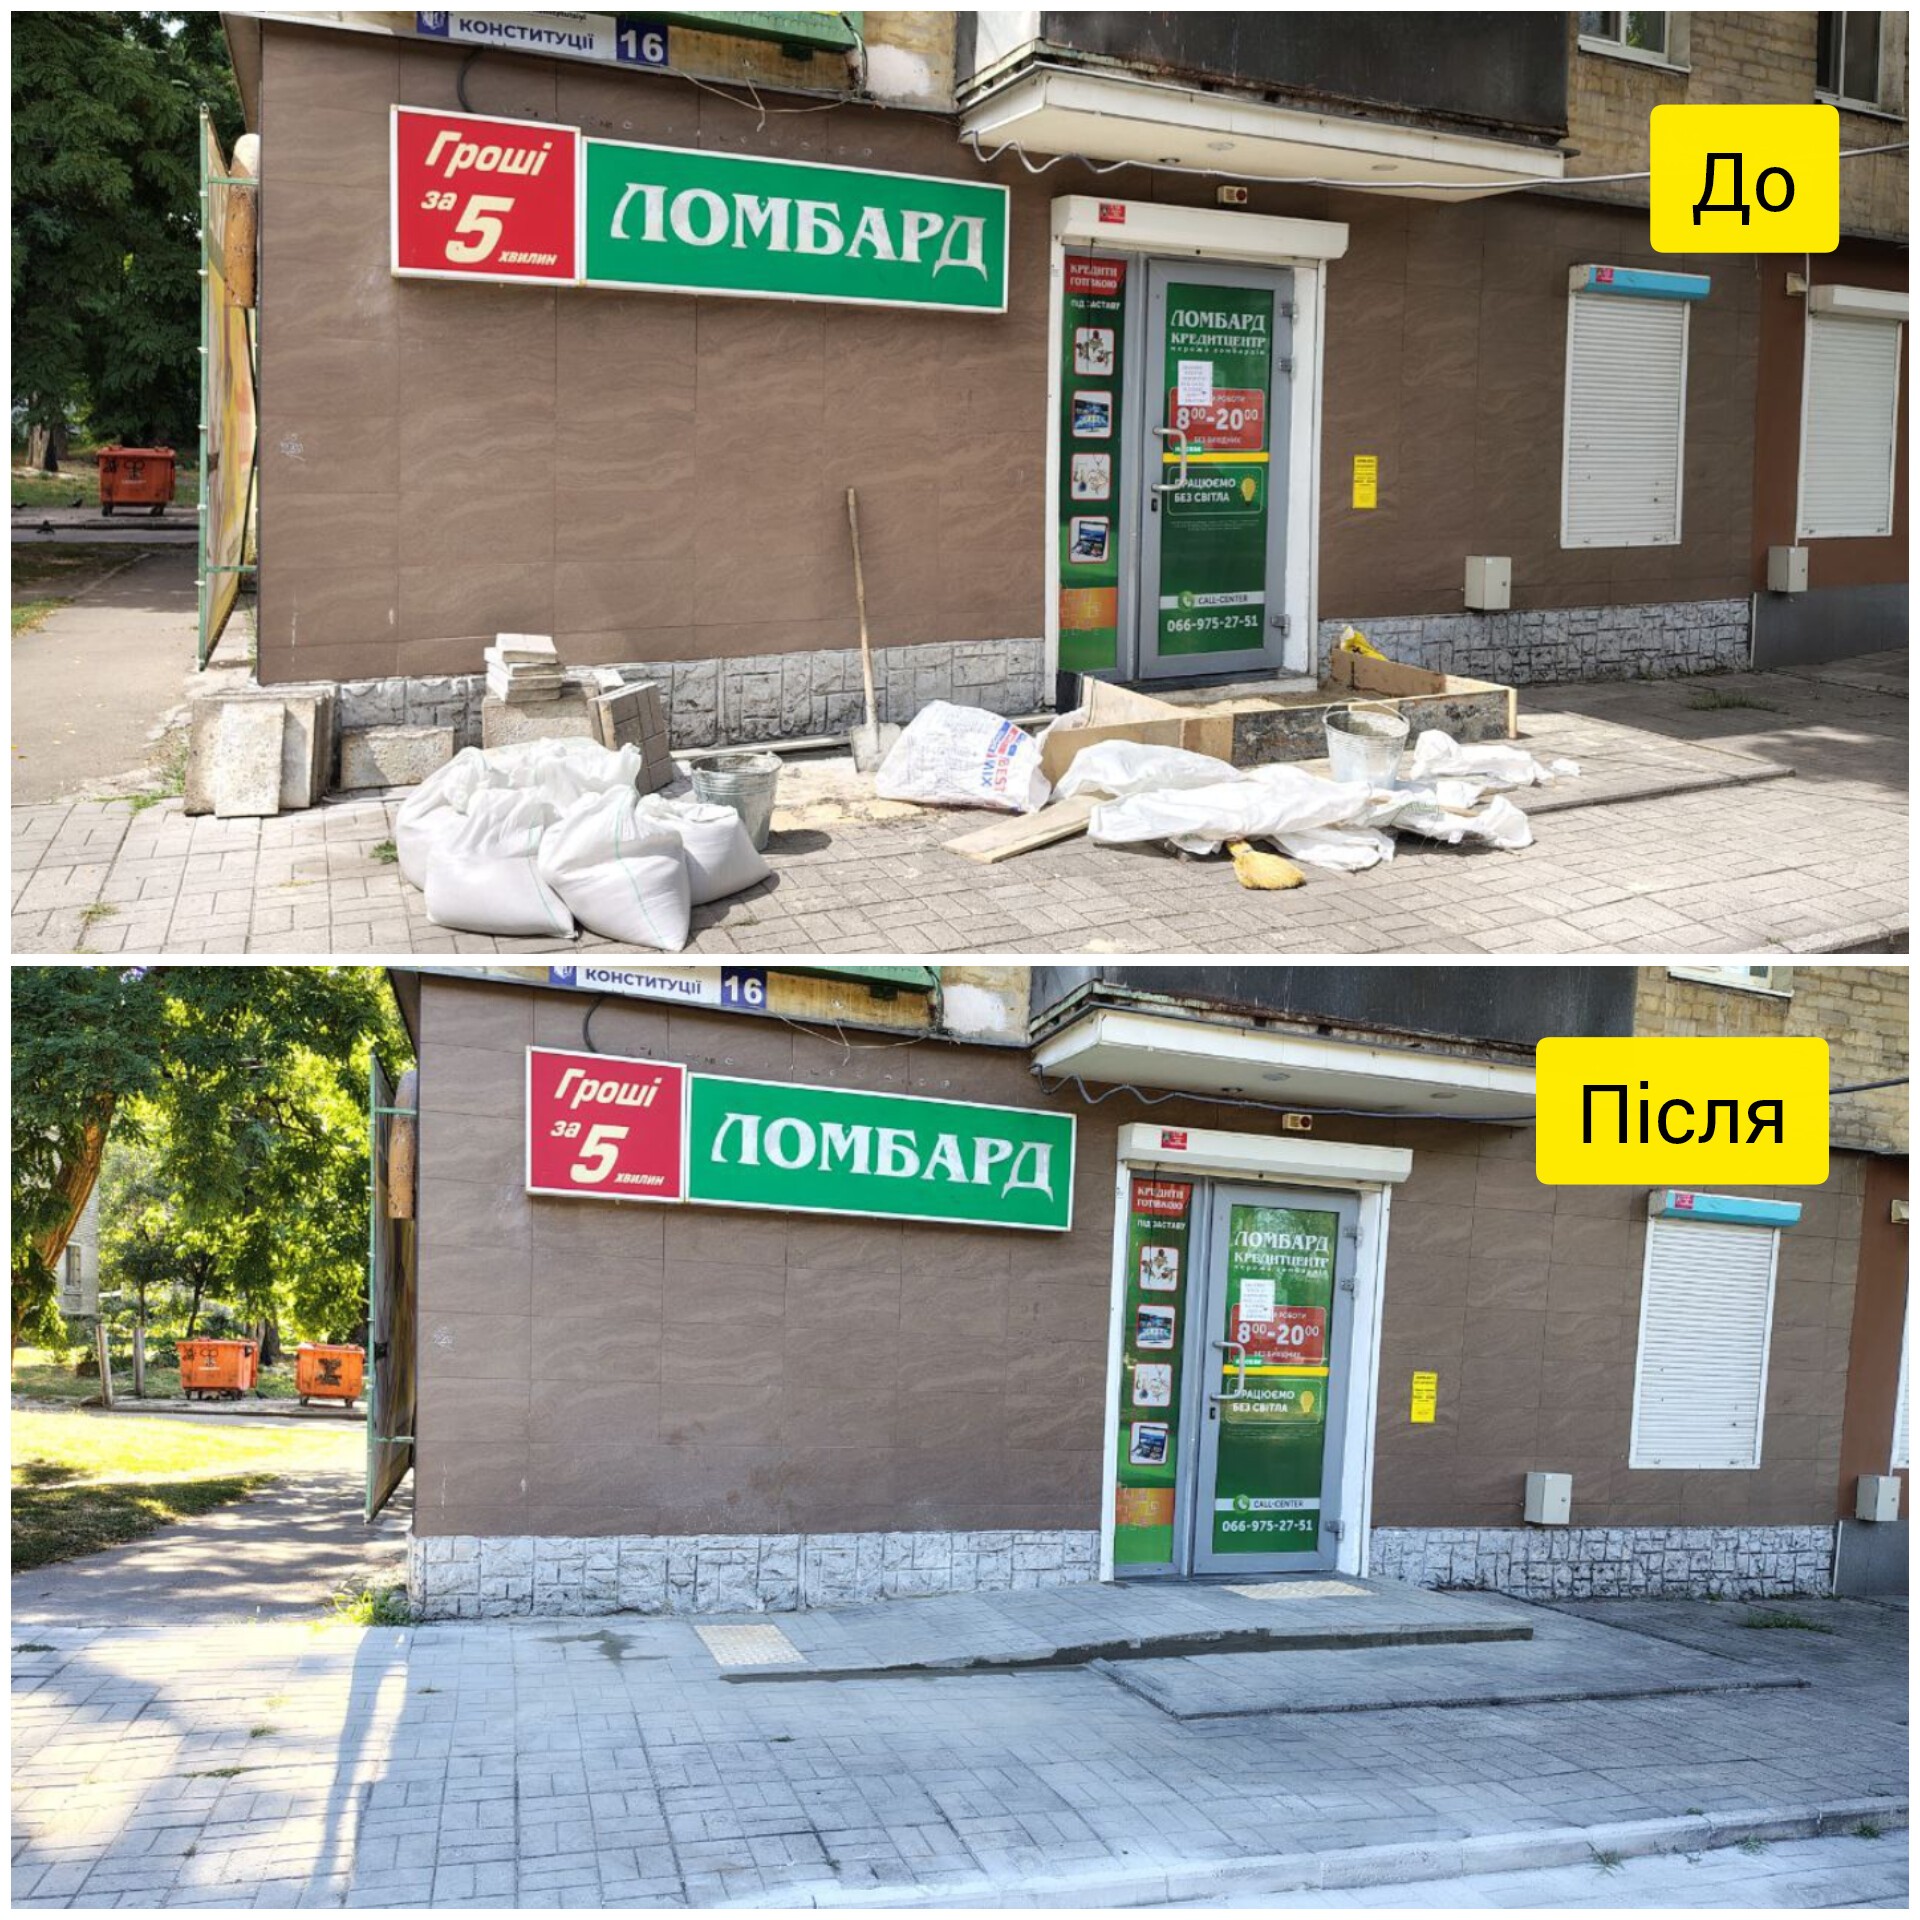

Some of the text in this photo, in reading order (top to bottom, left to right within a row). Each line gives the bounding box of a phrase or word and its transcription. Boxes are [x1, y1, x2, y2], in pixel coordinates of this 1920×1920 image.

[459, 18, 594, 50] КОНСТИТУЦІЇ
[619, 29, 664, 63] 16
[424, 130, 553, 179] Гроші
[420, 190, 516, 264] за 5
[610, 182, 989, 283] ЛОМБАРД
[498, 250, 558, 266] хвилин
[1170, 309, 1266, 334] ЛОМБАРД
[1170, 332, 1267, 349] КРЕДИТЦЕНТР
[1174, 491, 1231, 503] БЕЗ СВІТЛА
[1198, 594, 1249, 605] CALL-CENTER
[1166, 614, 1259, 632] 066-975-27-51
[585, 968, 702, 995] КОНСТИТУЦІЇ
[724, 974, 763, 1005] 16
[554, 1067, 663, 1110] Гроші
[550, 1119, 630, 1184] за 5
[710, 1112, 1055, 1203] ЛОМБАРД
[613, 1172, 665, 1187] хвилин
[1234, 1231, 1330, 1256] ЛОМБАРД
[1234, 1252, 1330, 1268] КРЕДИТЦЕНТР
[1232, 1402, 1288, 1413] БЕЗ СВІТЛА
[1253, 1500, 1304, 1509] CALL-CENTER
[1222, 1520, 1313, 1532] 066-975-27-51
